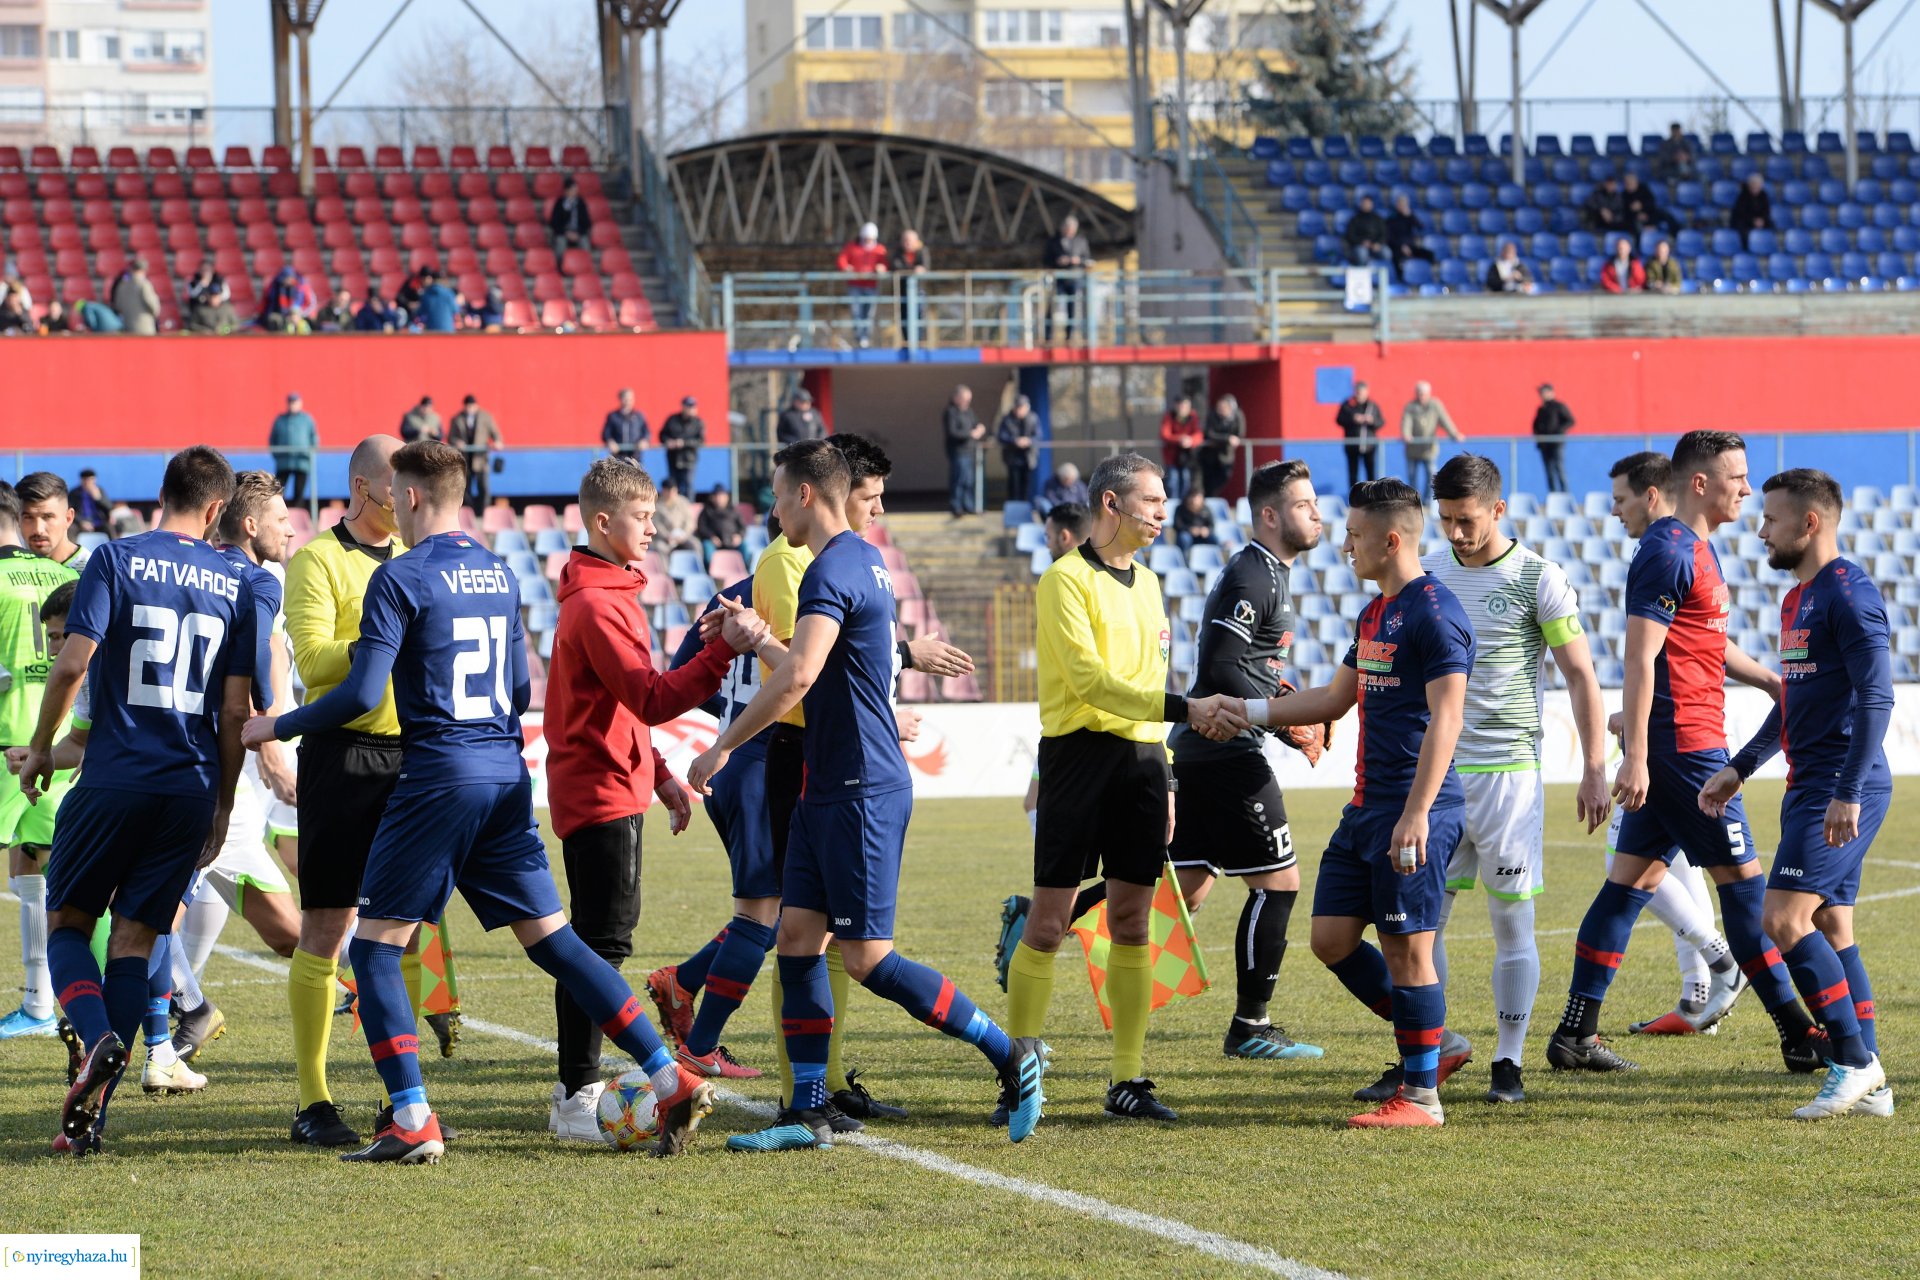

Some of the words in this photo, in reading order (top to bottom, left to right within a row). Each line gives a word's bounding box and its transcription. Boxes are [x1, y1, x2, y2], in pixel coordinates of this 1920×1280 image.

[130, 556, 241, 602] PATVAROS
[1566, 614, 1581, 635] C
[127, 604, 225, 716] 20
[452, 615, 512, 721] 21
[1368, 675, 1401, 687] TRANS
[1273, 823, 1293, 859] 13
[1726, 822, 1746, 856] 5
[1496, 866, 1527, 876] Zeus
[1780, 866, 1804, 877] JAKO
[1385, 913, 1407, 922] JAKO
[1499, 1010, 1527, 1021] Zeus
